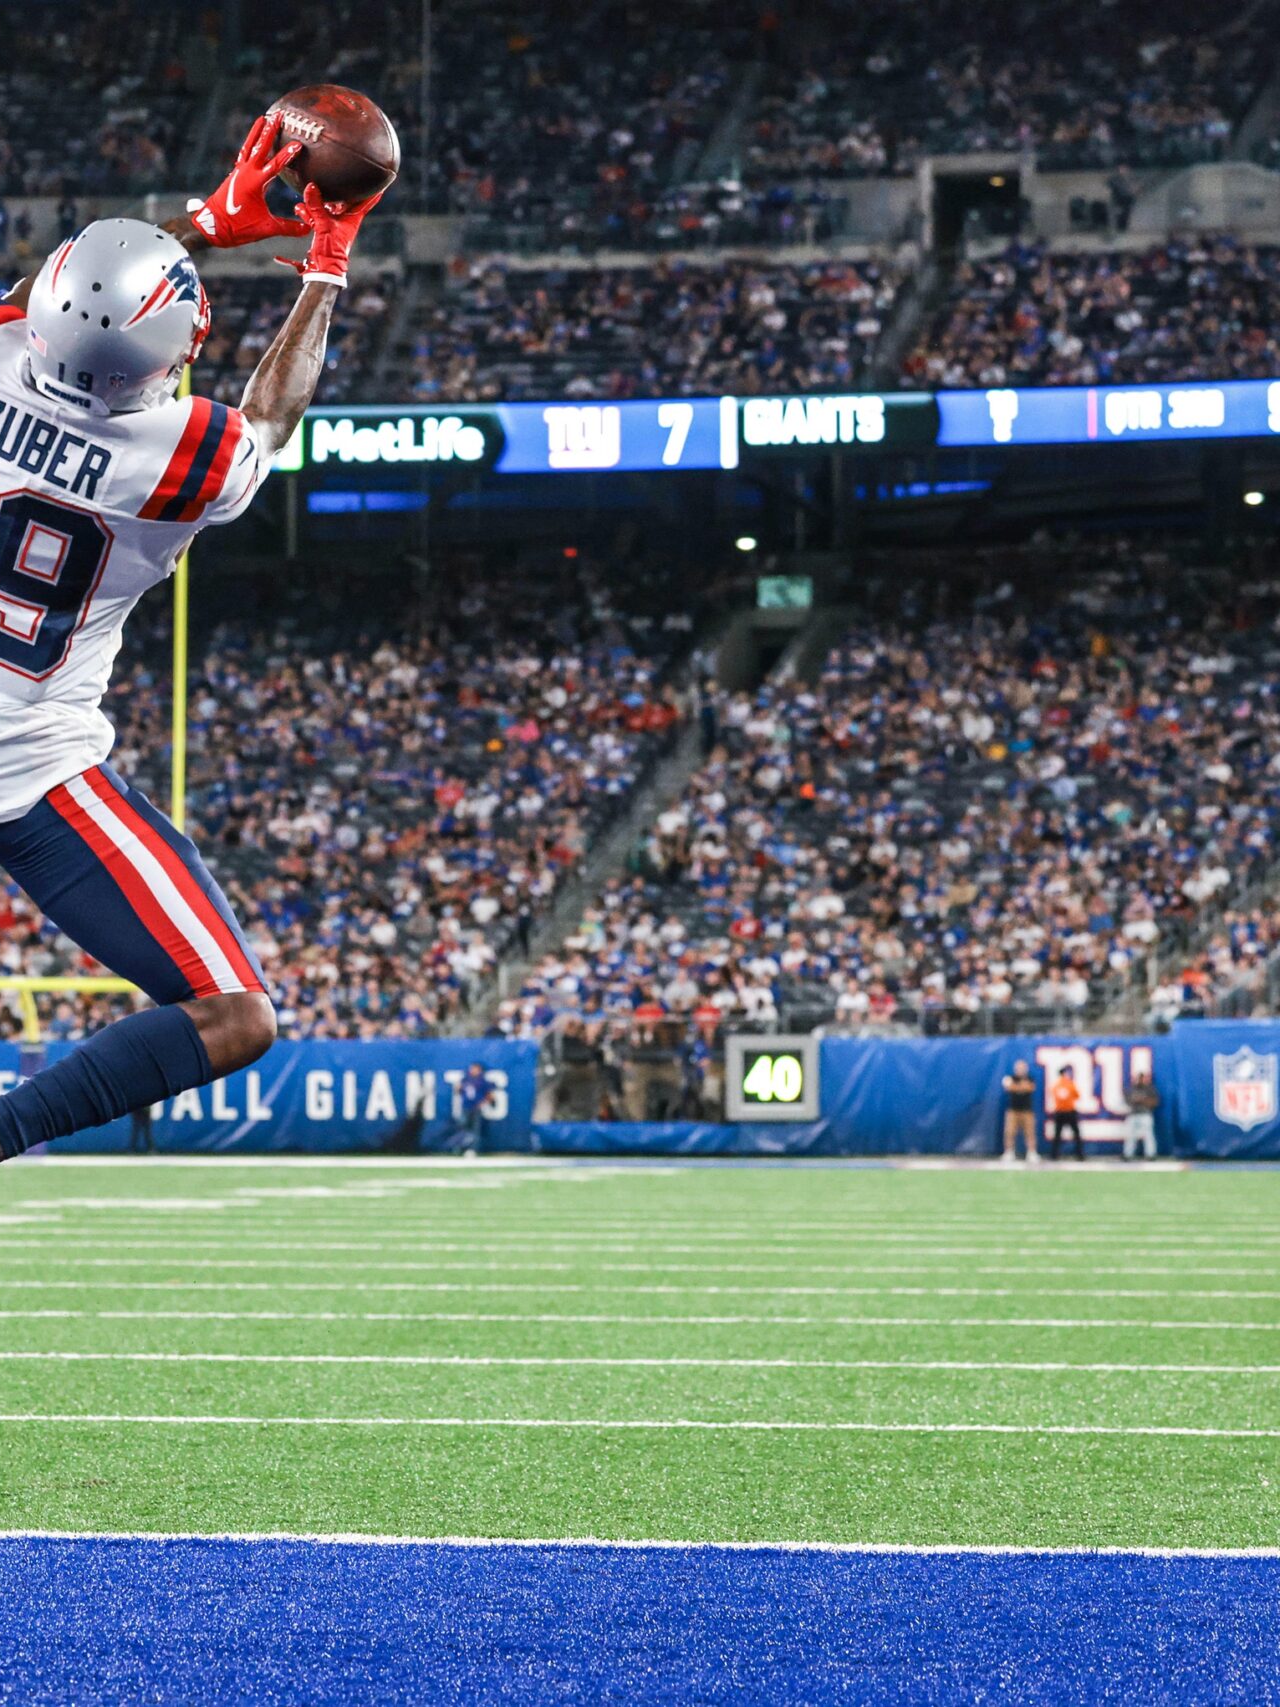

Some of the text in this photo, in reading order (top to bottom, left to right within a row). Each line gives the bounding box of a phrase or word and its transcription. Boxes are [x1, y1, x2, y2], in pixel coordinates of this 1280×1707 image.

[58, 362, 93, 392] 19
[313, 416, 485, 463] MetLife
[657, 402, 694, 465] 7
[743, 396, 885, 445] GIANTS
[305, 1069, 509, 1121] GIANTS
[744, 1055, 802, 1102] 40
